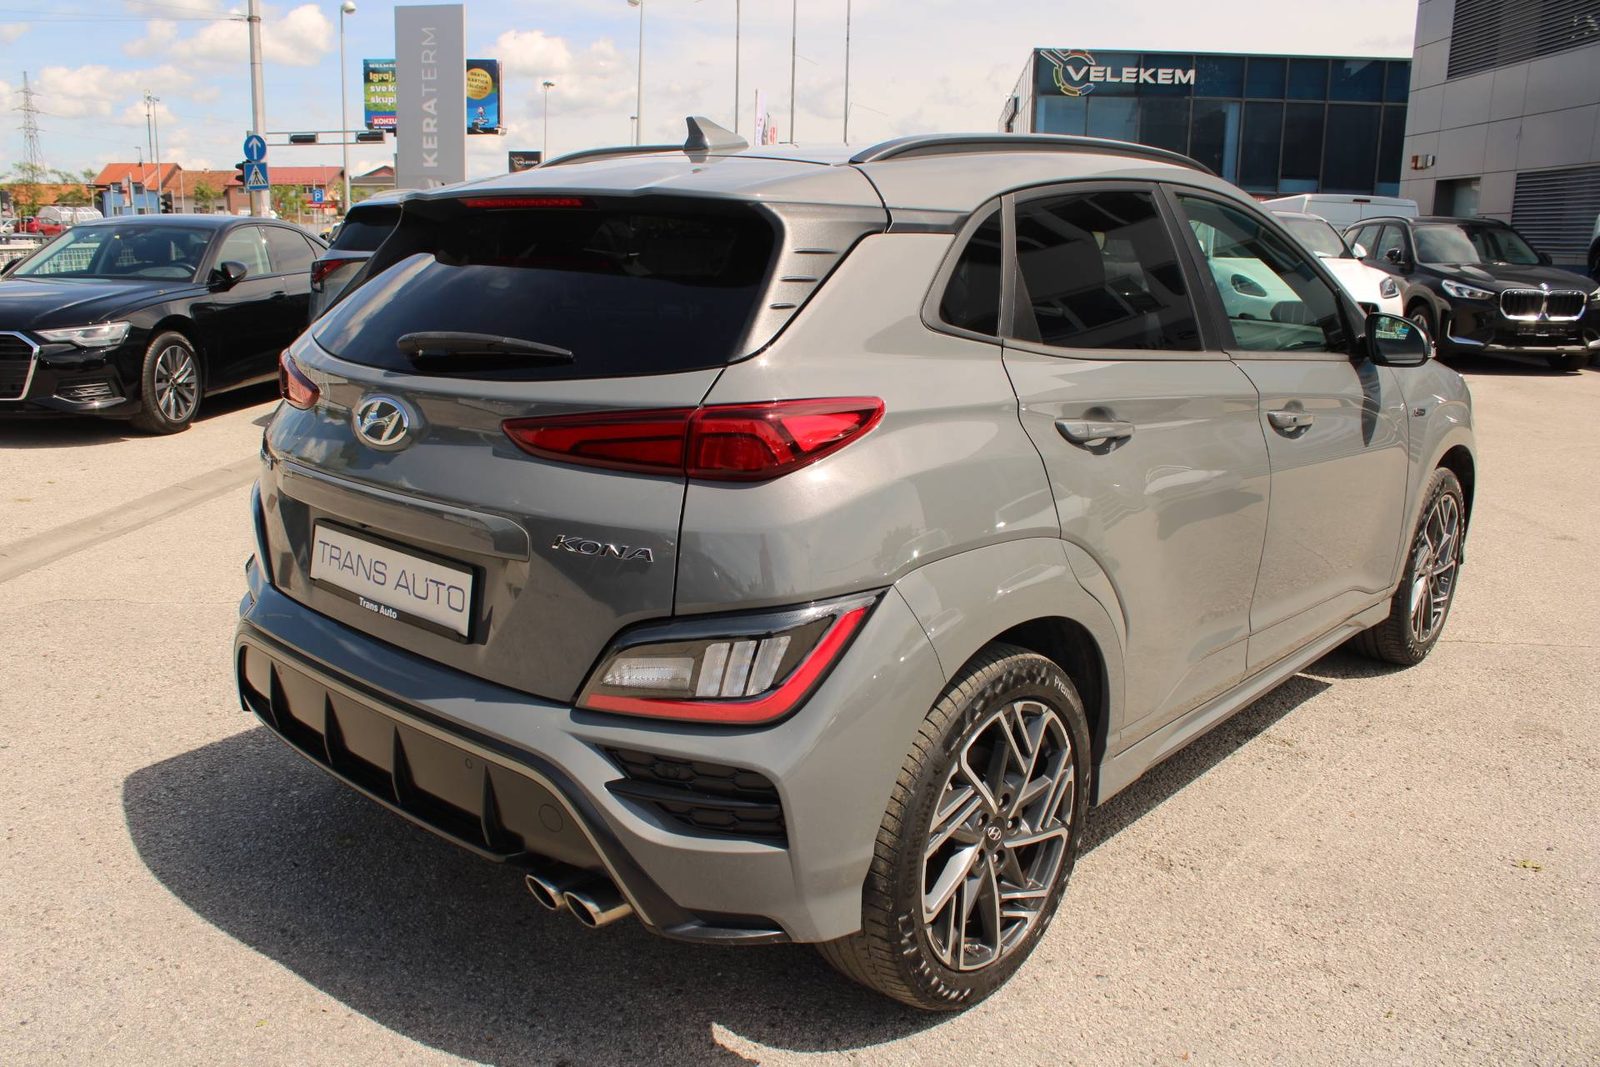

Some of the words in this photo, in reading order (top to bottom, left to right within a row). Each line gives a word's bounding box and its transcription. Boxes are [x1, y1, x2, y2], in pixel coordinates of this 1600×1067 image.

[1066, 65, 1196, 85] VELEKEM
[421, 27, 438, 167] KERATERM
[552, 534, 654, 562] KONA
[318, 540, 388, 586] TRANS
[394, 569, 466, 613] AUTO
[359, 597, 379, 613] Trans
[379, 604, 398, 619] Auto
